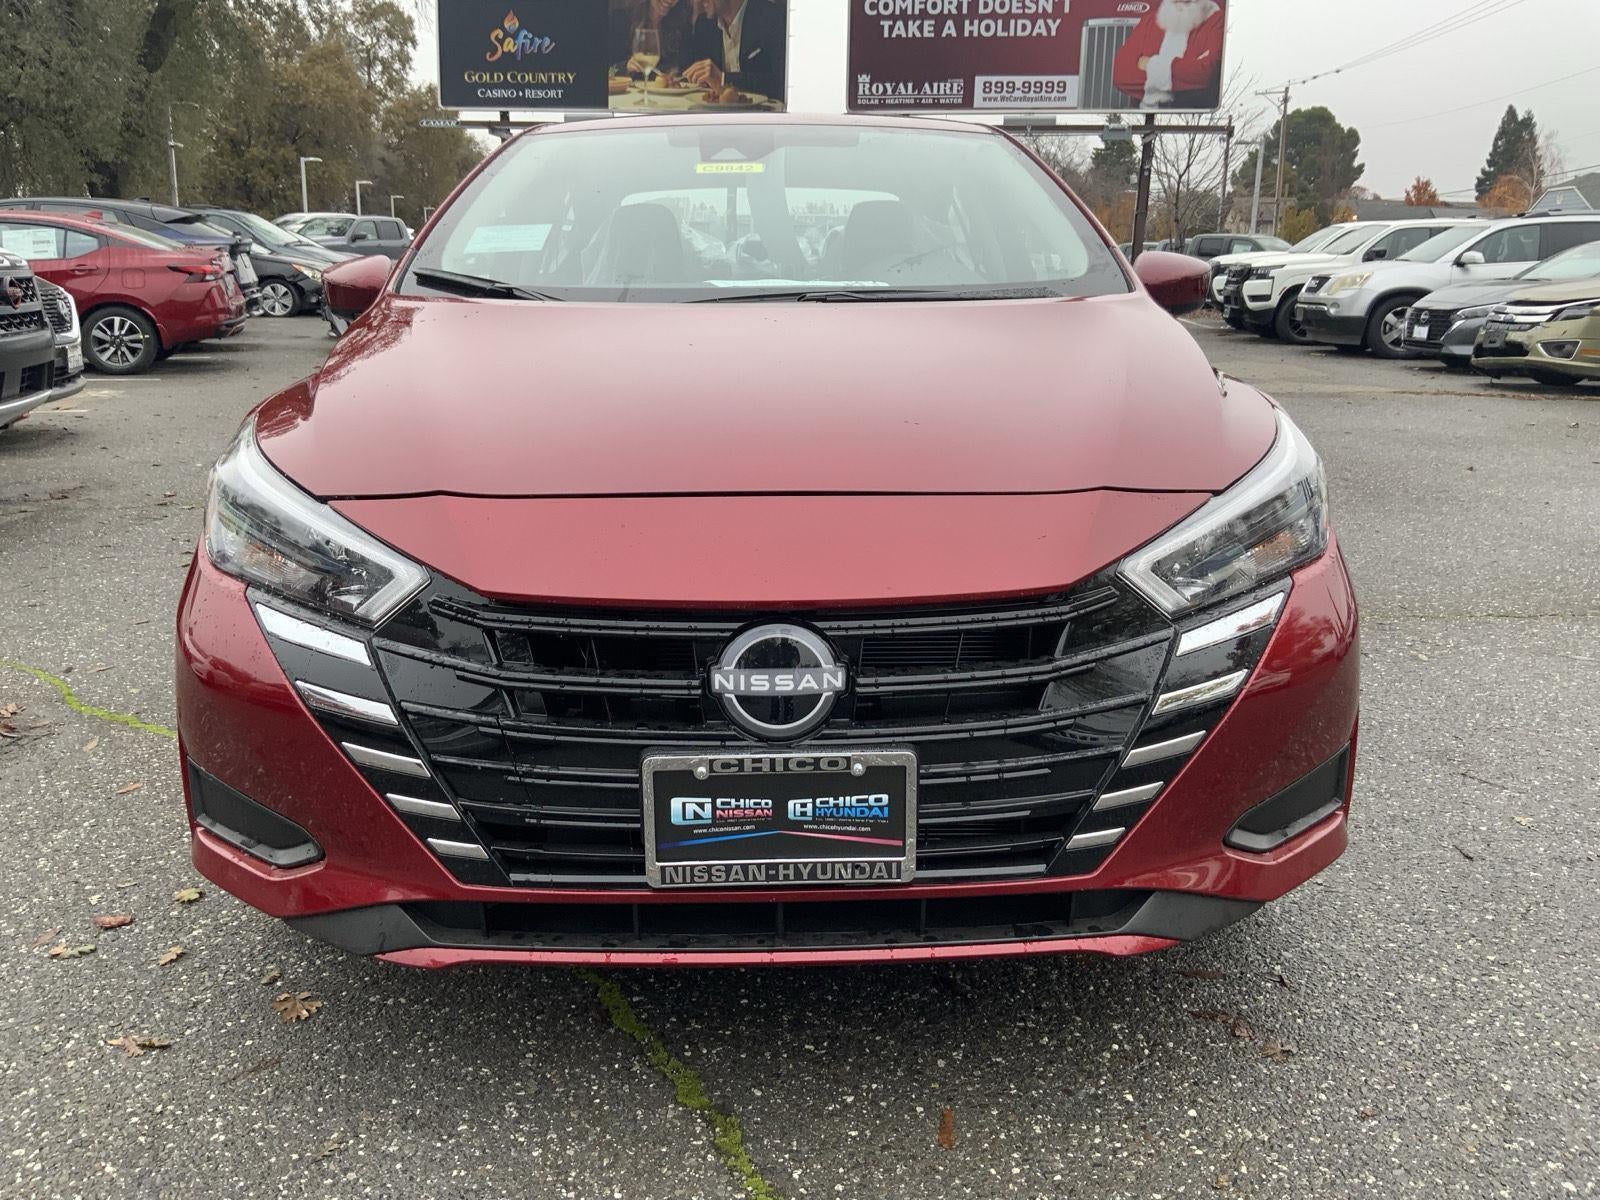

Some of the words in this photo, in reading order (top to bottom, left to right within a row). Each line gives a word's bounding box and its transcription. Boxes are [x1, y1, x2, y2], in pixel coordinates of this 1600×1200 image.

[864, 0, 971, 15] COMFORT
[880, 20, 935, 38] TAKE
[941, 19, 957, 37] A
[964, 18, 1062, 37] HOLIDAY
[486, 28, 556, 61] Safire
[464, 71, 504, 83] GOLD
[507, 71, 577, 84] COUNTRY
[477, 88, 517, 98] CASINO
[525, 89, 564, 99] RESORT
[857, 82, 918, 95] ROYAL
[920, 82, 964, 95] AIRE
[982, 80, 1067, 94] 899-9999
[714, 671, 843, 691] NISSAN
[712, 757, 848, 773] CHICO
[716, 798, 773, 808] CHICO
[816, 794, 889, 807] CHICO
[716, 809, 773, 818] NISSAN
[816, 807, 889, 817] HYUNDAI
[693, 824, 756, 834] www.chiconissan.com
[803, 824, 871, 832] www.chicohyundai.com
[664, 862, 899, 884] NISSAN-HYUNDAI
